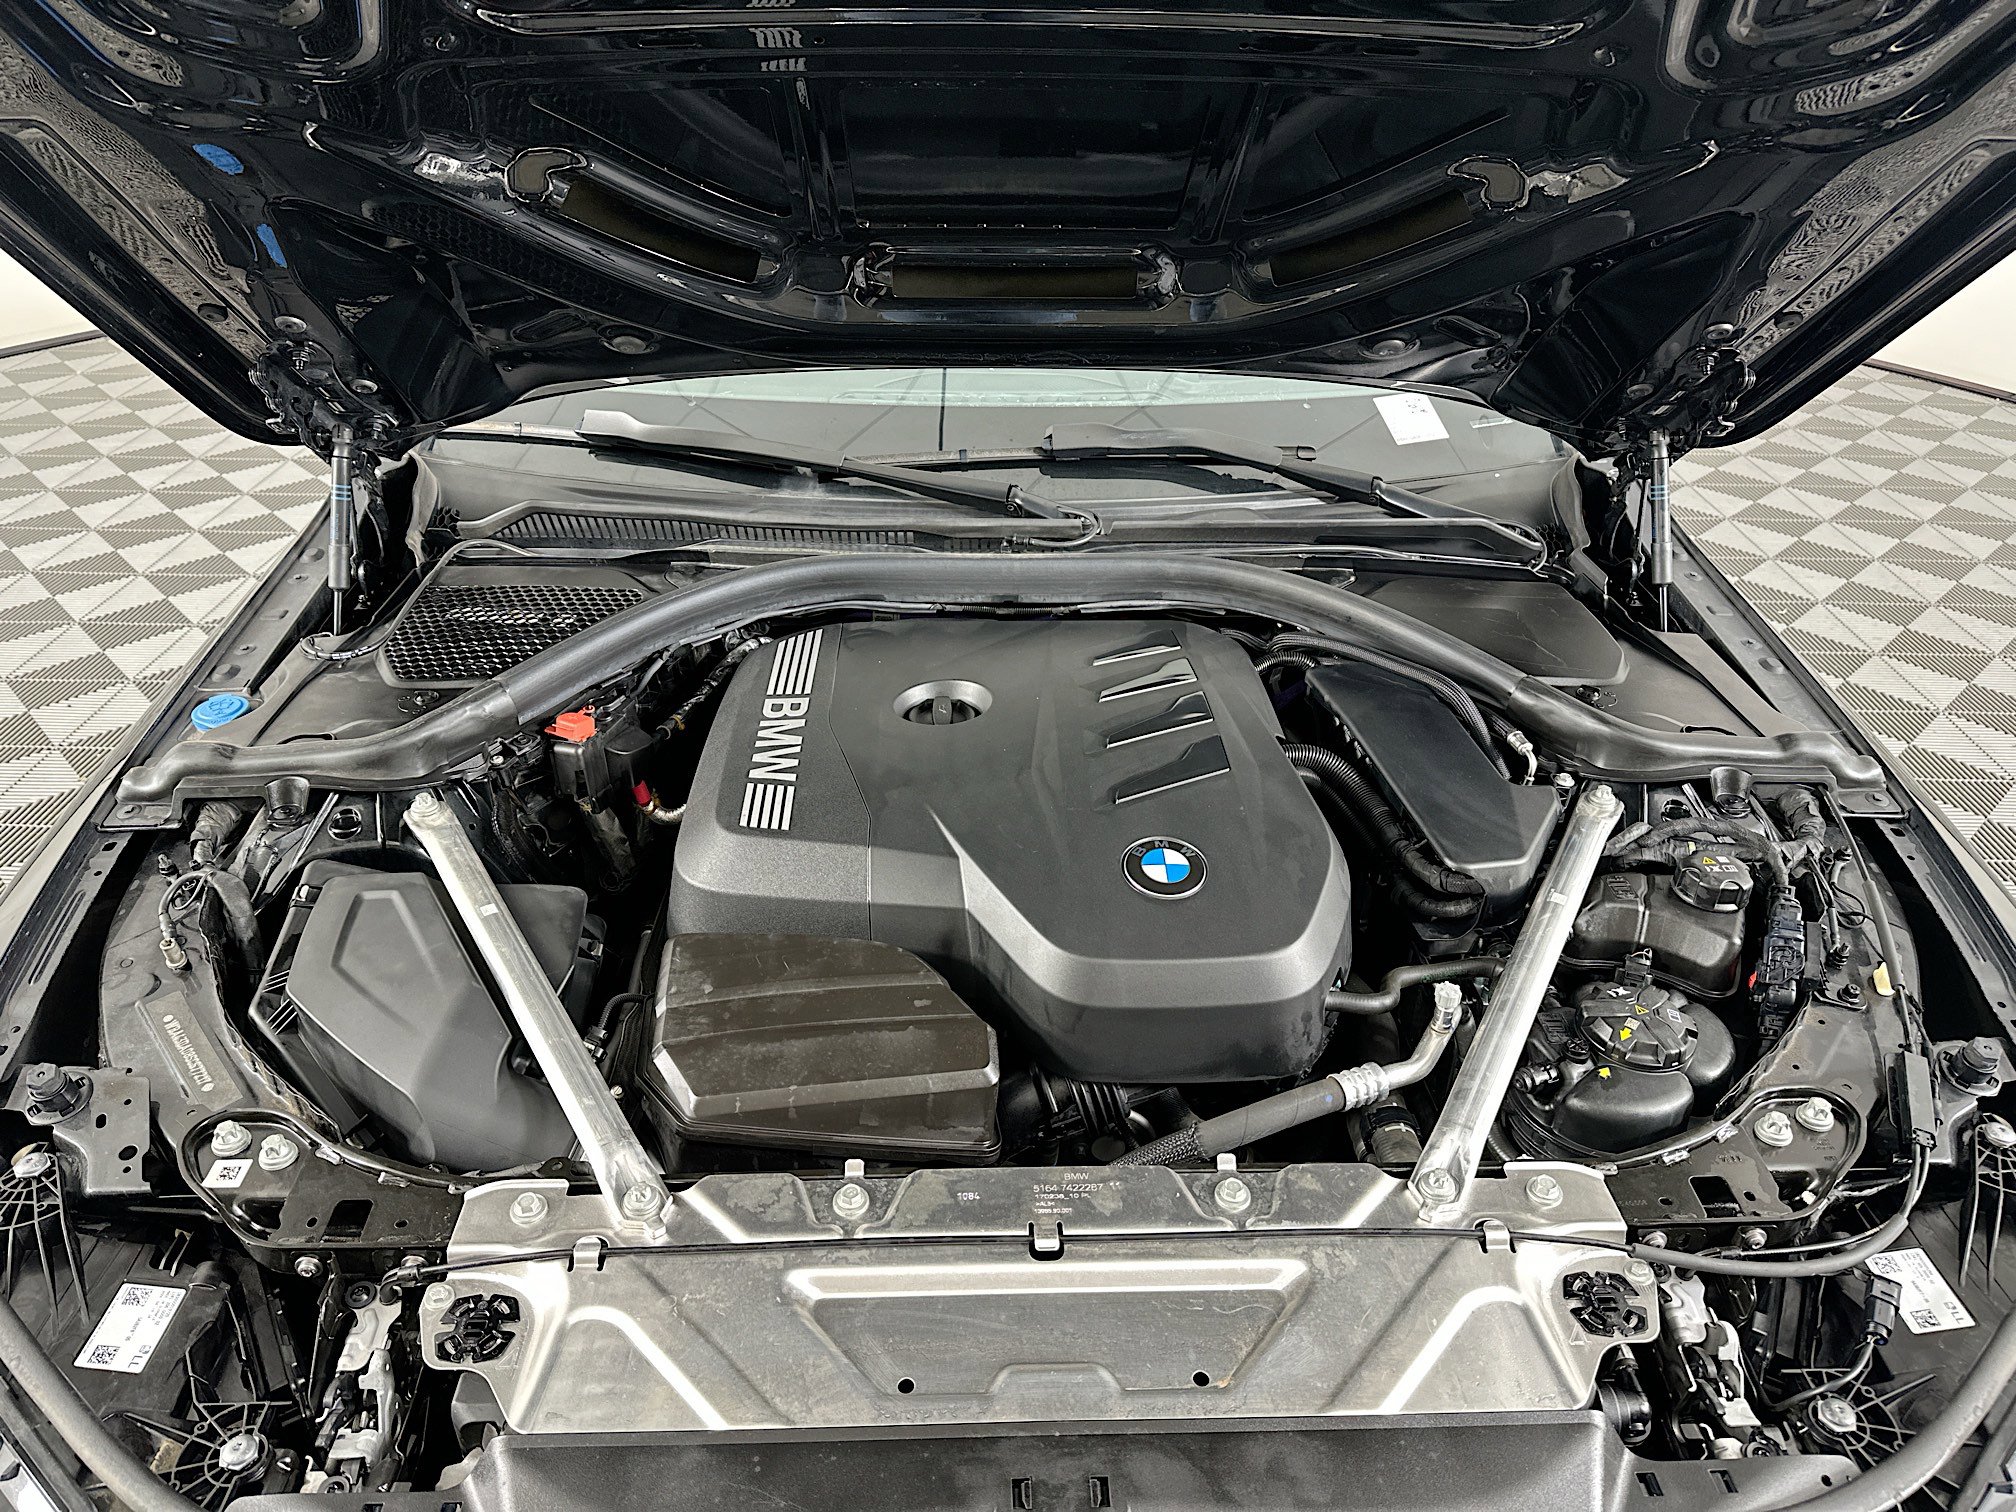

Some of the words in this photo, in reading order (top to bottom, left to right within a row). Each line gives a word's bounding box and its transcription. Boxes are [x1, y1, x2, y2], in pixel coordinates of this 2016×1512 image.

[748, 697, 810, 782] BMW
[1131, 840, 1197, 857] BMW
[1063, 1172, 1090, 1181] BMW
[1033, 1184, 1058, 1193] 5164
[956, 1191, 981, 1201] 1084
